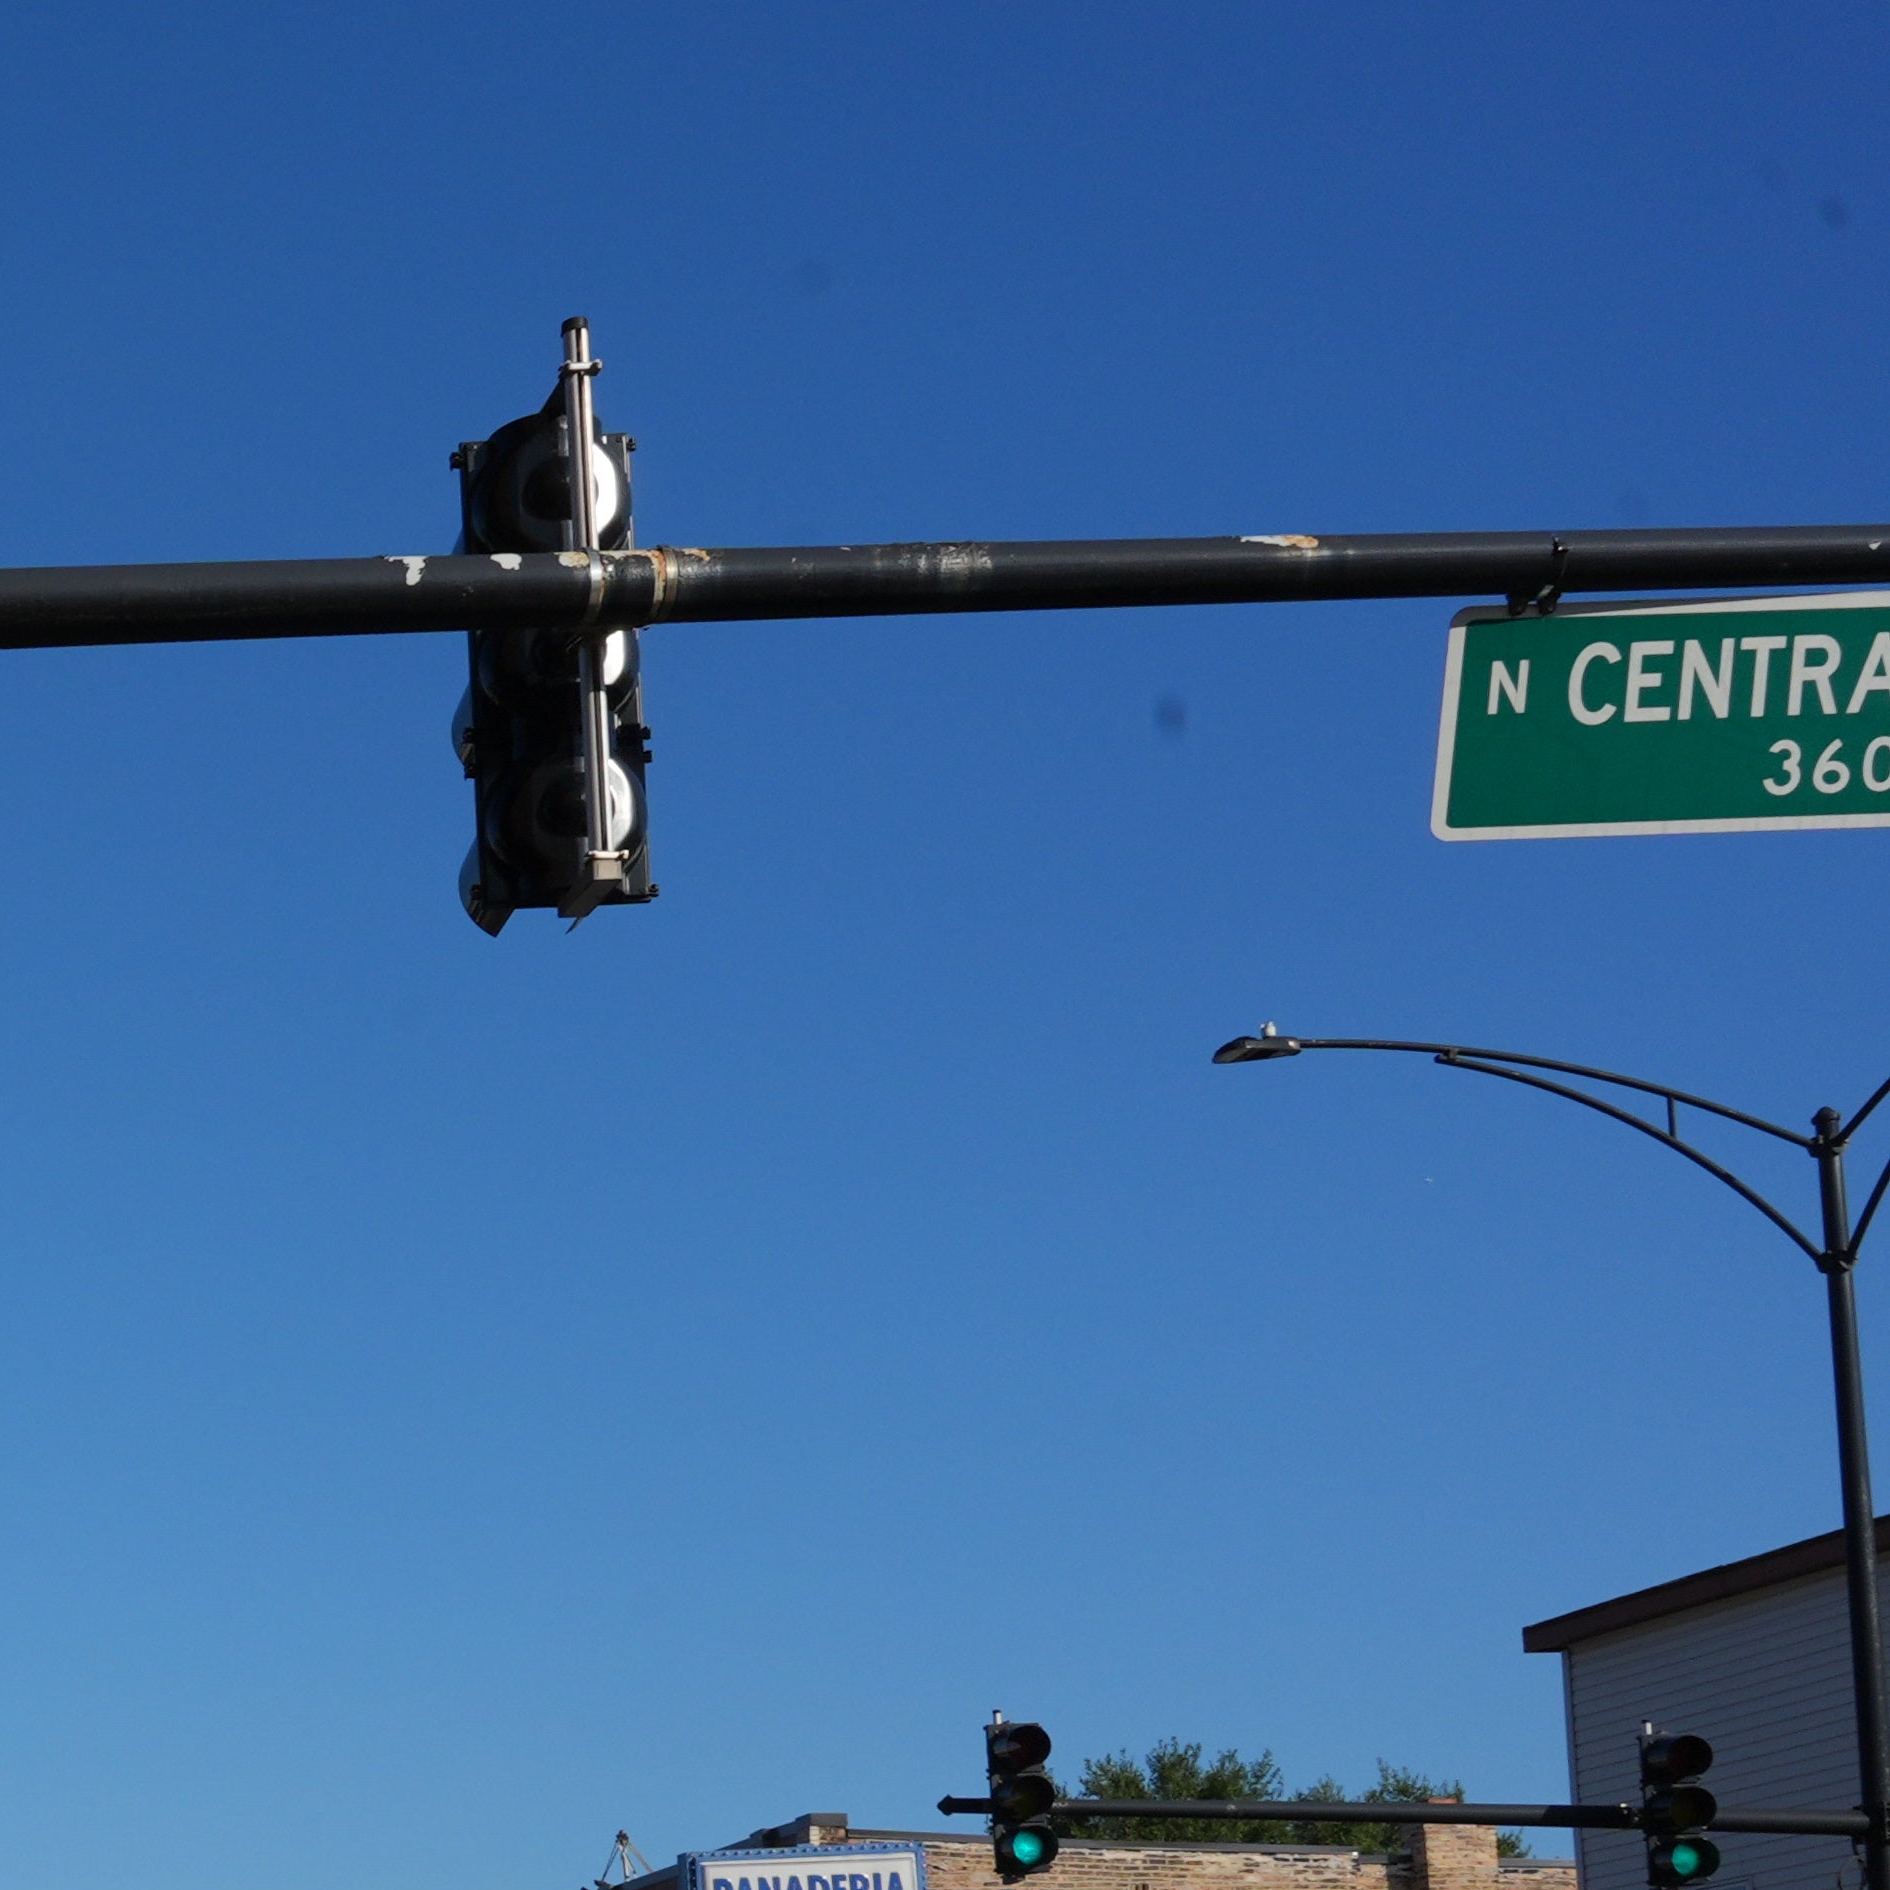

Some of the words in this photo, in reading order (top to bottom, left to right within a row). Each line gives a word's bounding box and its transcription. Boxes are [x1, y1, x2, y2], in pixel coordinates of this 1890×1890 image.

[1487, 659, 1530, 716] N
[1567, 631, 1890, 726] CENTRA
[1763, 736, 1890, 797] 360
